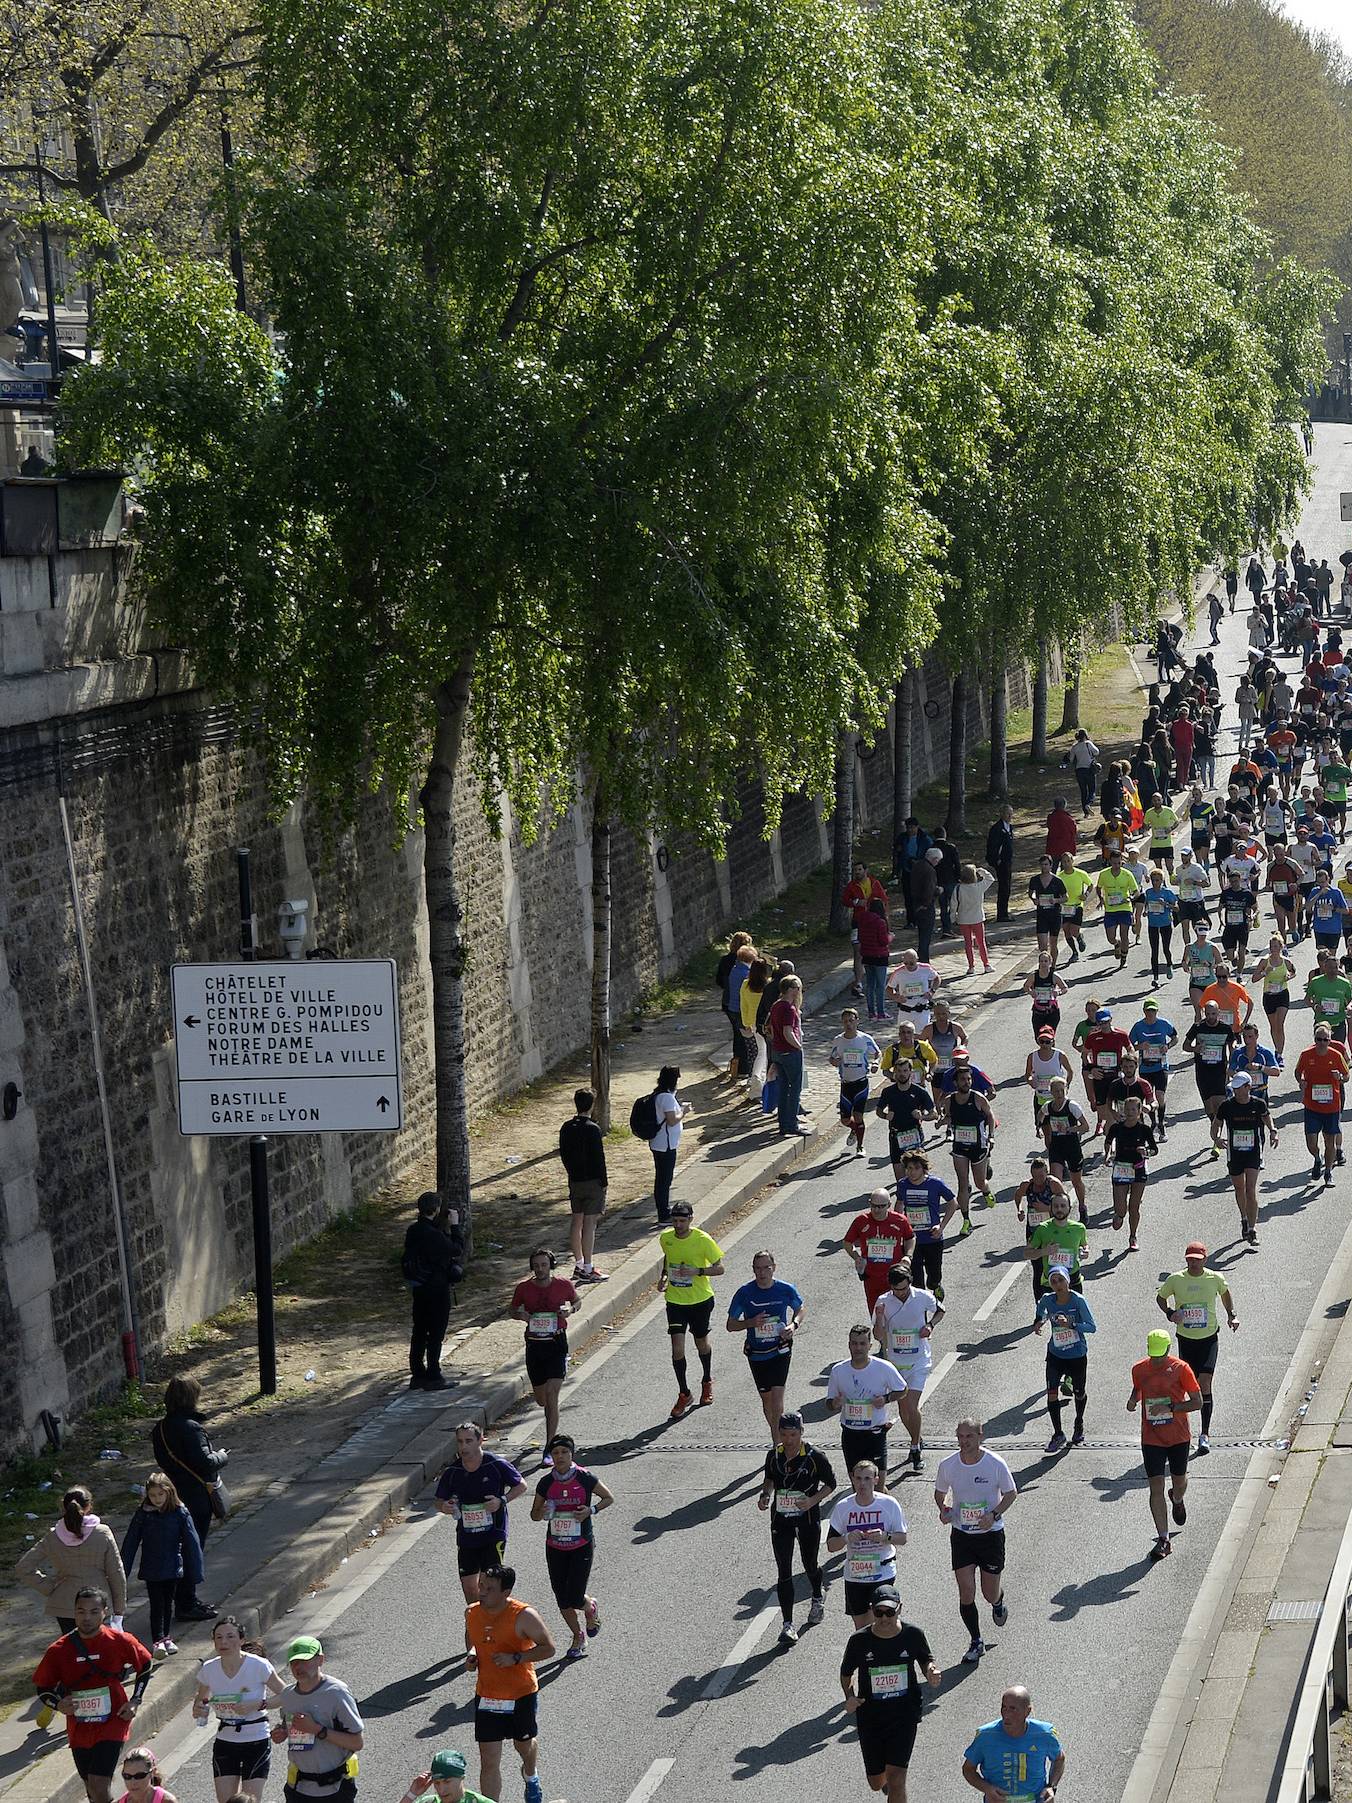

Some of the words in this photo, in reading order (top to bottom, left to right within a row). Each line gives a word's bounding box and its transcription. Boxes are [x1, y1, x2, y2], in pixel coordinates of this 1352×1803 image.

[205, 974, 286, 990] CHÂTELET
[206, 990, 258, 1004] HÔTEL
[264, 991, 284, 1003] DE
[291, 990, 335, 1002] VILLE
[207, 1007, 270, 1020] CENTRE
[277, 1006, 291, 1018] G.
[297, 1004, 382, 1018] POMPIDOU
[208, 1022, 264, 1035] FORUM
[272, 1021, 302, 1033] DES
[309, 1020, 369, 1032] HALLES
[208, 1038, 261, 1051] NOTRE
[268, 1037, 313, 1049] DAME
[209, 1050, 282, 1066] THÉÂTRE
[289, 1052, 308, 1064] DE
[315, 1051, 333, 1063] LA
[341, 1050, 385, 1062] VILLE
[211, 1092, 287, 1105] BASTILLE
[212, 1110, 254, 1123] GARE
[279, 1109, 319, 1121] LYON
[848, 1511, 882, 1524] MATT
[876, 1675, 898, 1686] 22162
